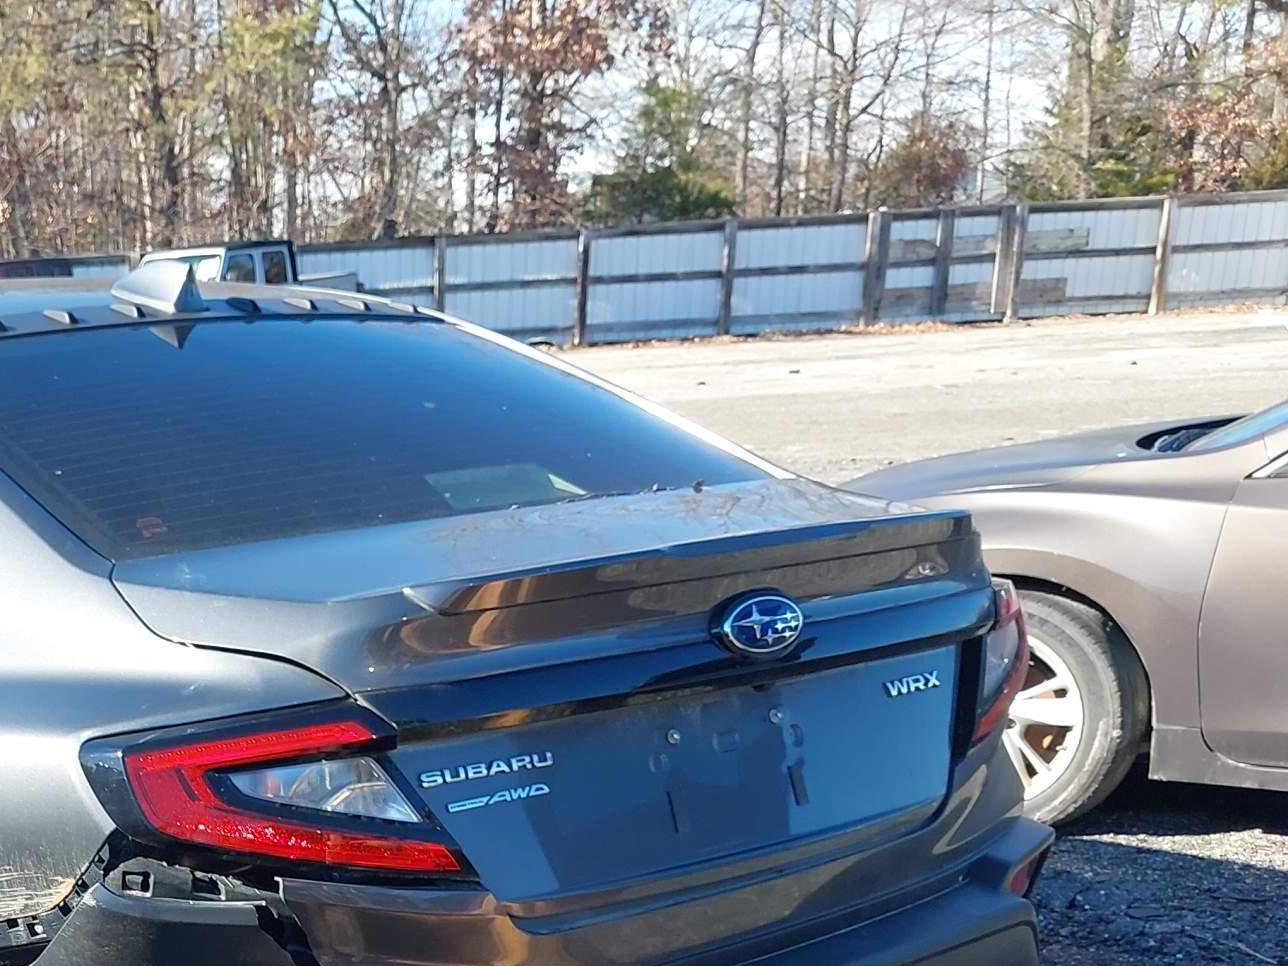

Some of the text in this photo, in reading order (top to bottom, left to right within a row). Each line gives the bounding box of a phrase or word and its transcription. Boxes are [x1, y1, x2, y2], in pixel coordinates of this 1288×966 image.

[884, 670, 941, 697] WRX
[419, 751, 554, 788] SUBARU
[487, 783, 551, 805] AWD
